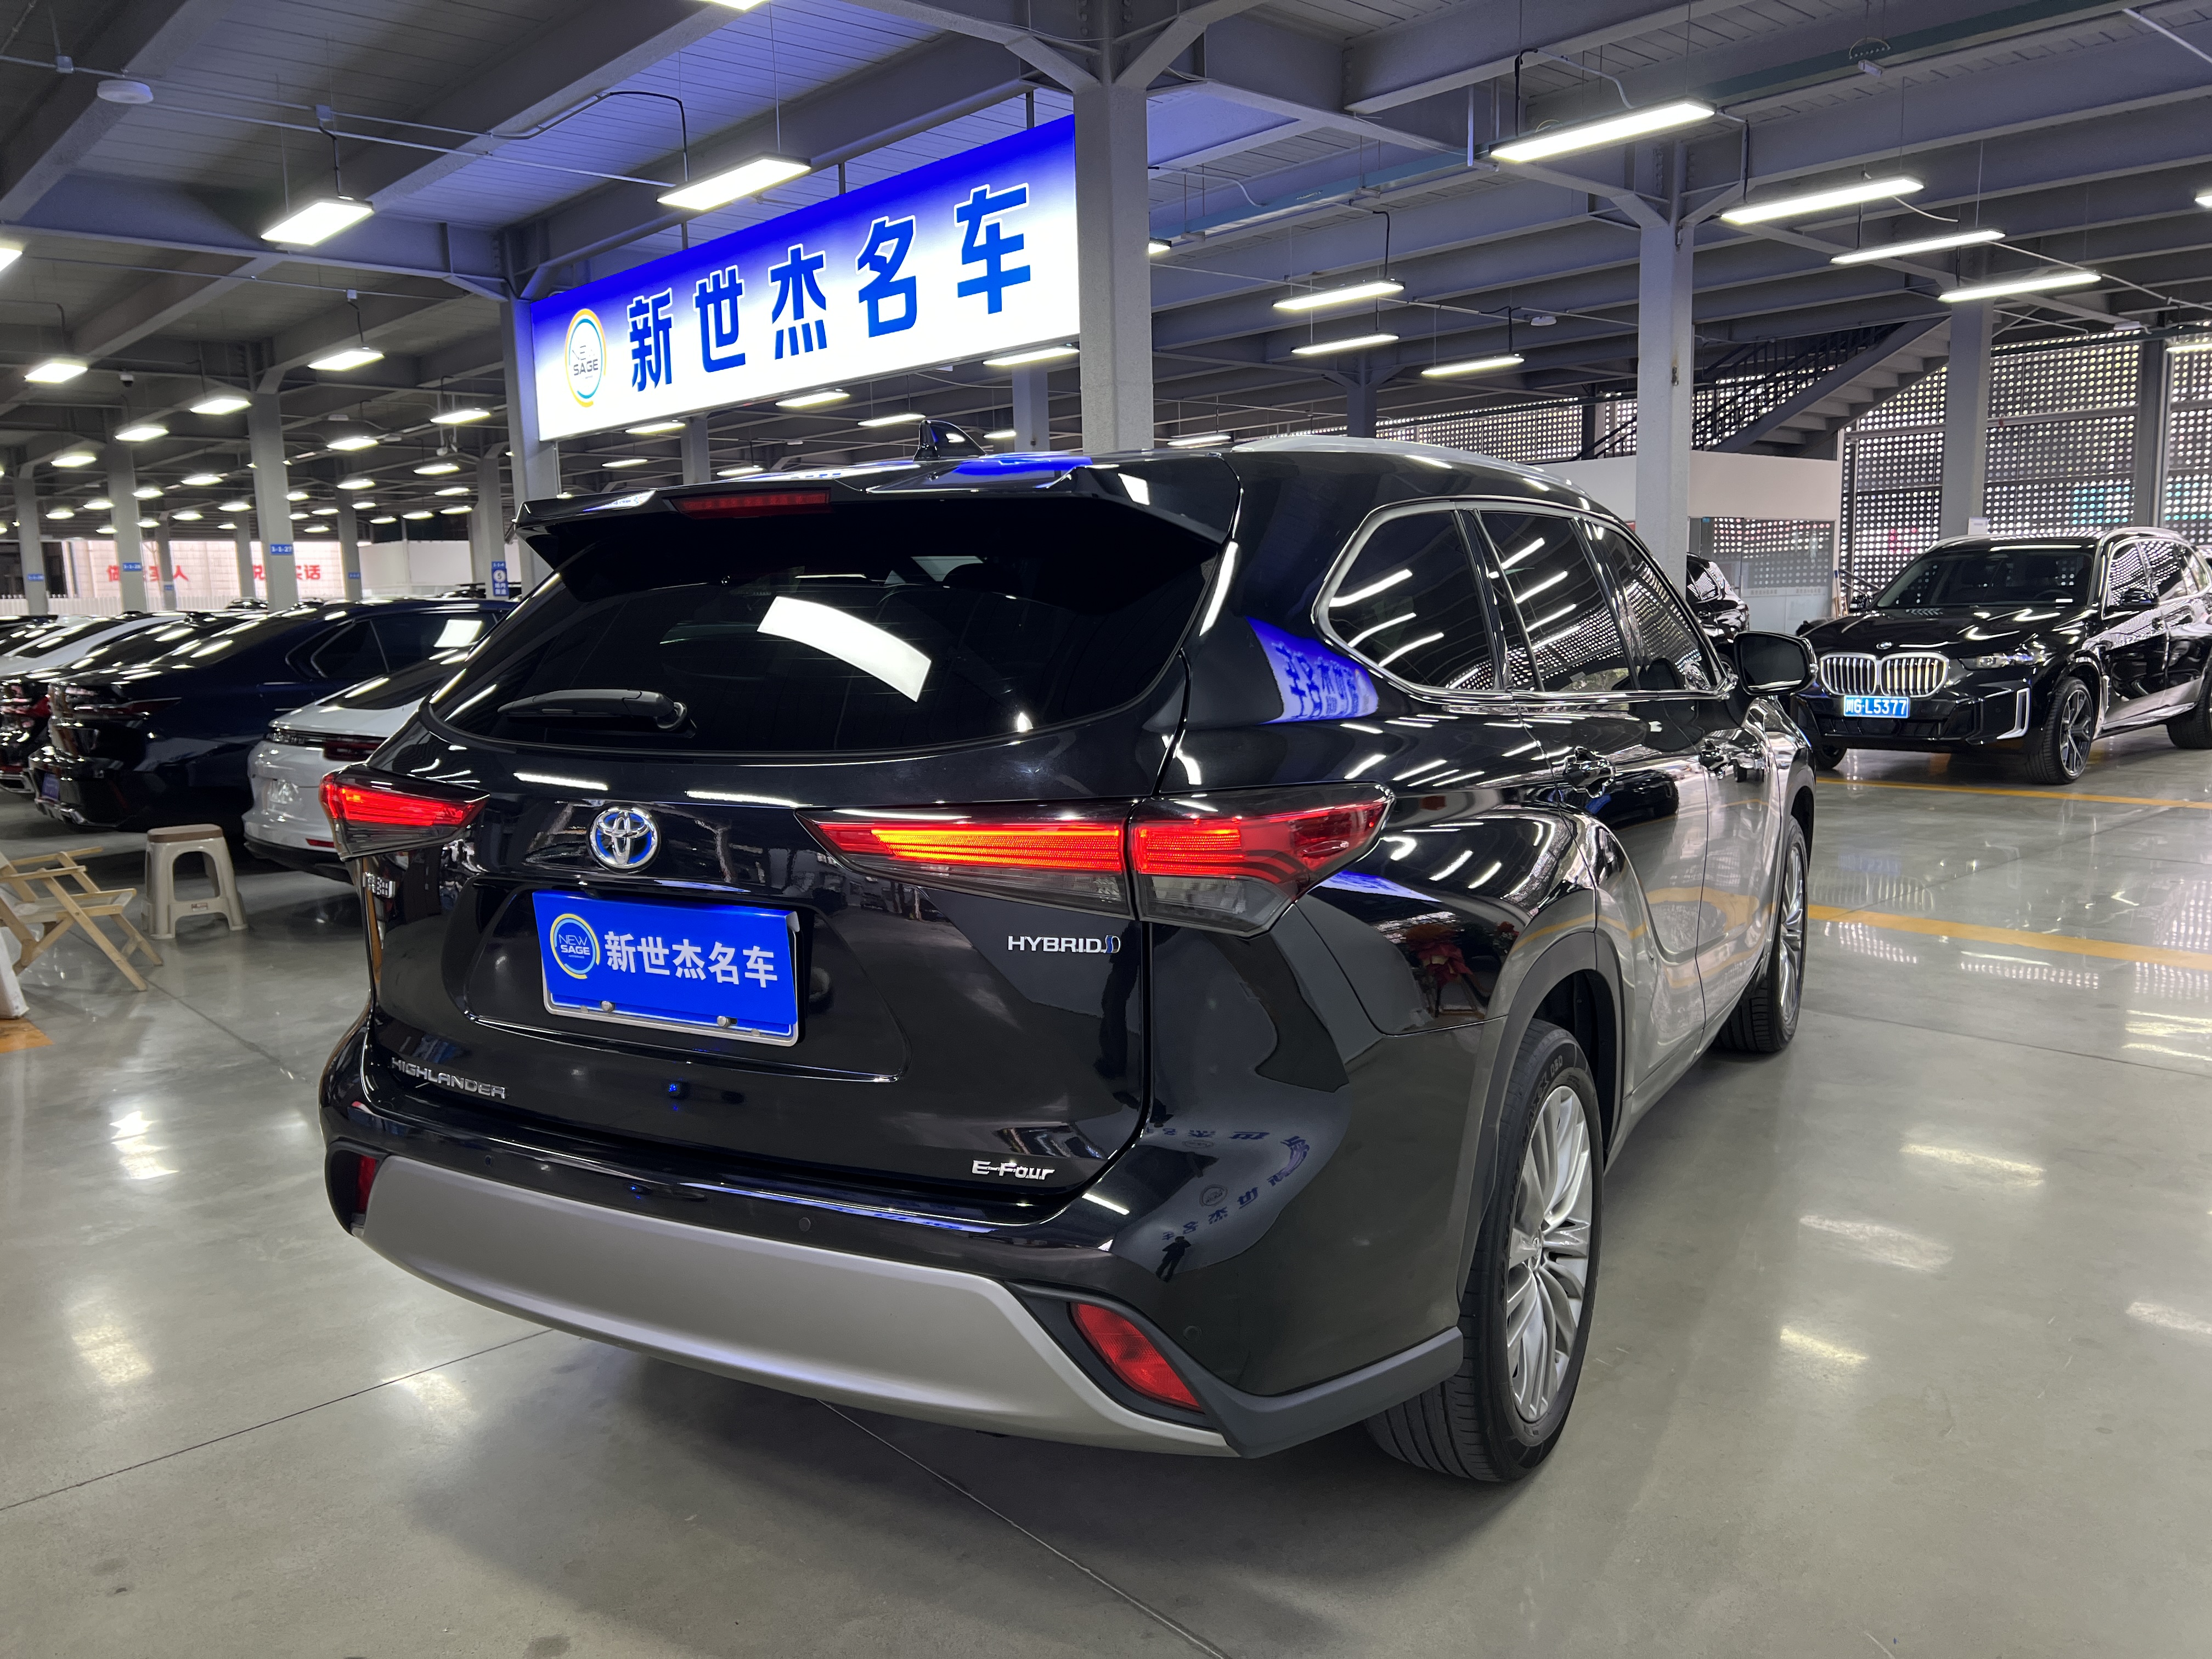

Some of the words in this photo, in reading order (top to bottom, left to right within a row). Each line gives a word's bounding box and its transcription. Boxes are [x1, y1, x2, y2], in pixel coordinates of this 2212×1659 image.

[627, 185, 1031, 392] 新世杰名车
[573, 358, 599, 376] SAGE
[558, 934, 588, 946] NEW
[1008, 935, 1102, 953] HYBRID
[560, 945, 591, 956] SAGE
[604, 931, 778, 988] 新世杰名车
[392, 1057, 505, 1099] HIGHLANDER
[972, 1160, 1056, 1180] E-Four
